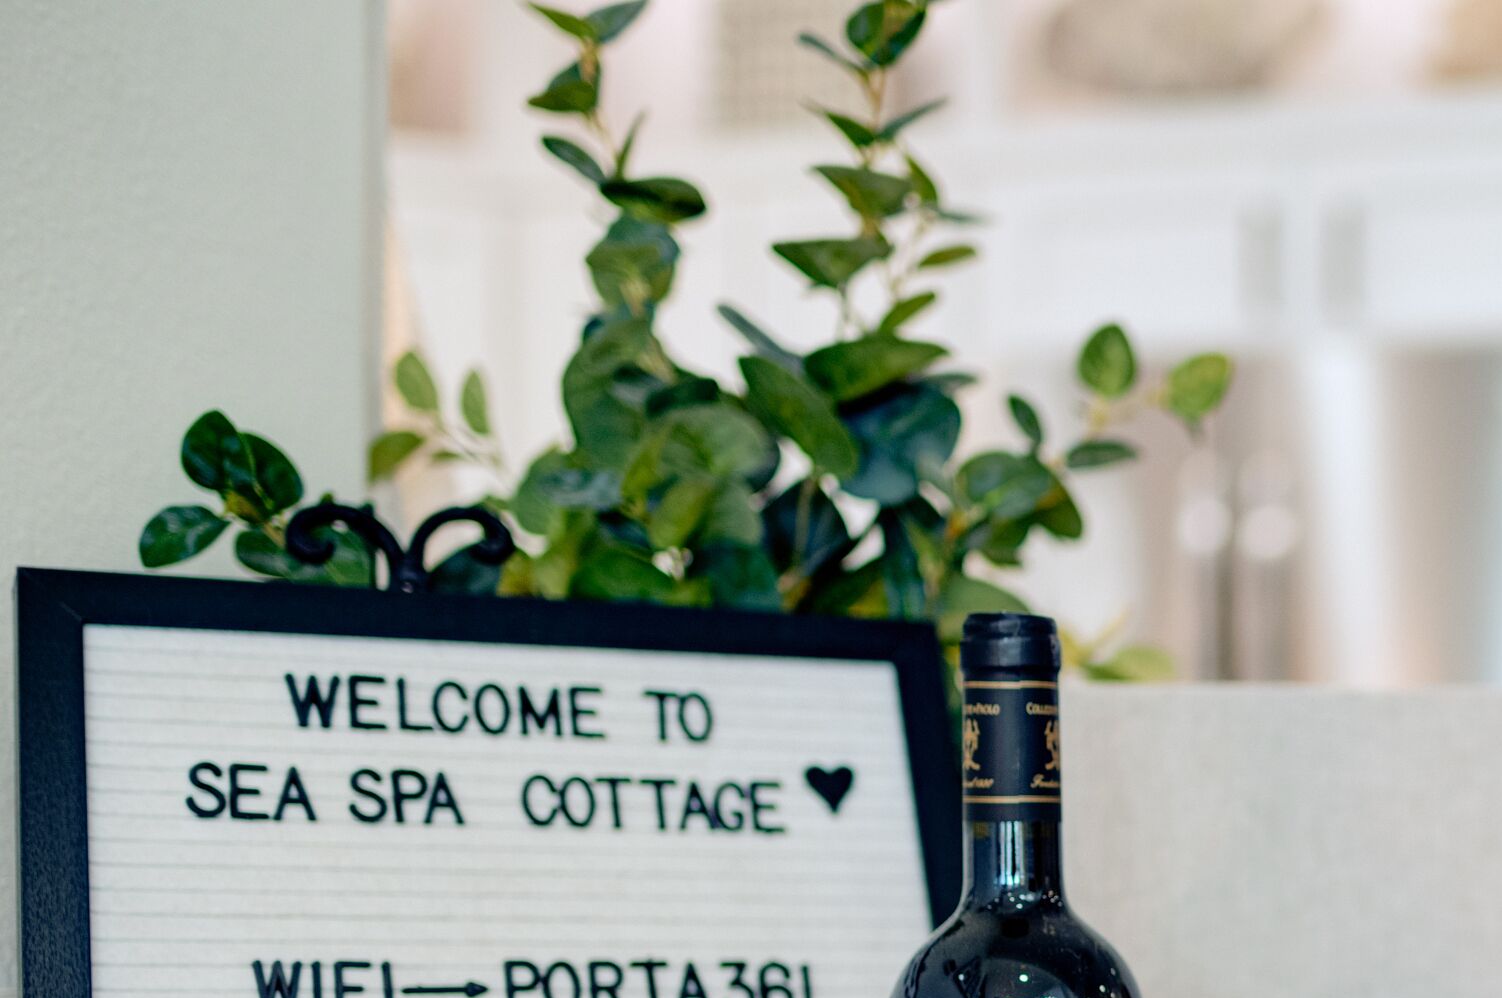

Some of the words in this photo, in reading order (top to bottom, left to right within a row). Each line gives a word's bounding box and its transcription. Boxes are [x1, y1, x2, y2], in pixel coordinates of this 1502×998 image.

[285, 674, 604, 738] WELCOME
[644, 690, 712, 742] TO
[185, 762, 317, 821] SEA
[348, 769, 465, 826] SPA
[522, 775, 786, 832] COTTAGE
